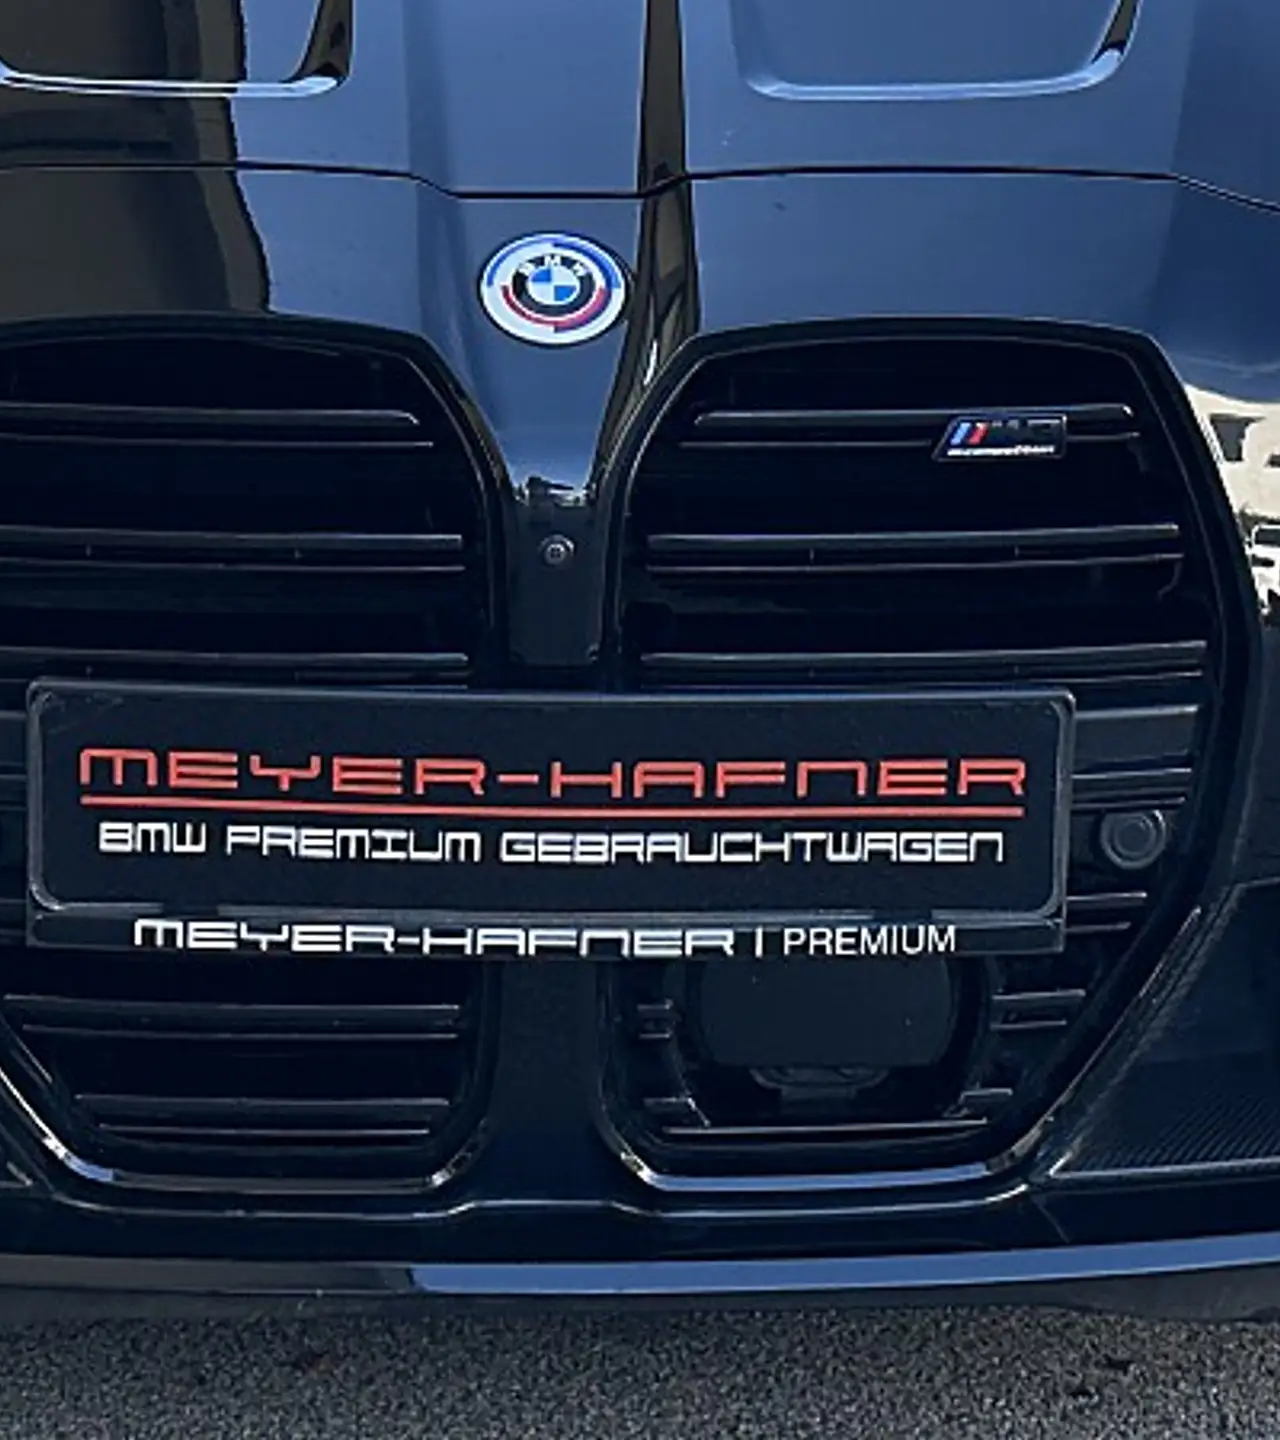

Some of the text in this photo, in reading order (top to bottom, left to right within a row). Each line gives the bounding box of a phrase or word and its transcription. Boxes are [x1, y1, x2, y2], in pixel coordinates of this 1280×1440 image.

[517, 253, 589, 279] BMW
[81, 747, 1027, 799] MEYER-HAFNER
[98, 821, 1004, 864] BMW PREMIUM GEBRAUCHTWAGEN
[134, 918, 736, 958] MEYER-HAFNER
[783, 924, 958, 956] PREMIUM
